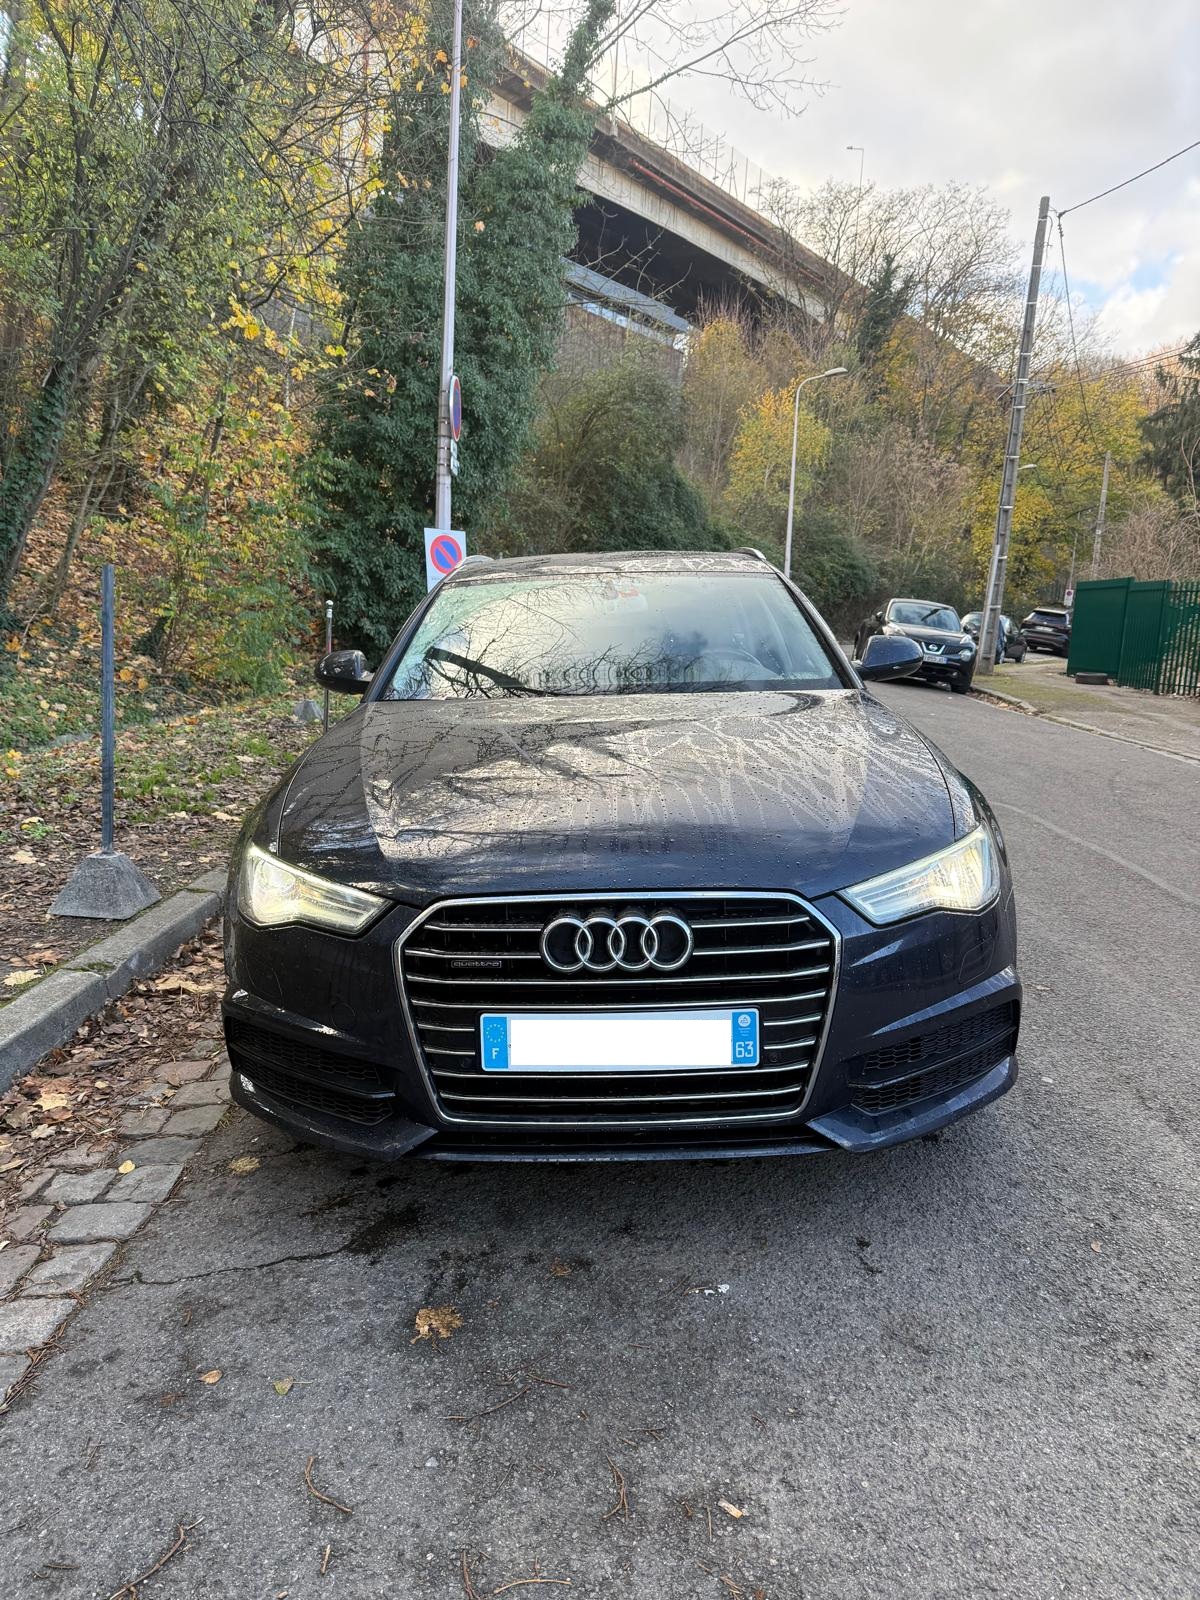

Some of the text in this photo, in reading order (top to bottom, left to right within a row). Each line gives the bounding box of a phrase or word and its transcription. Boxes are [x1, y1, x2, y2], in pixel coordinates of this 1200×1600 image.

[453, 960, 500, 968] quattro
[491, 1047, 500, 1060] F
[735, 1041, 754, 1058] 63
